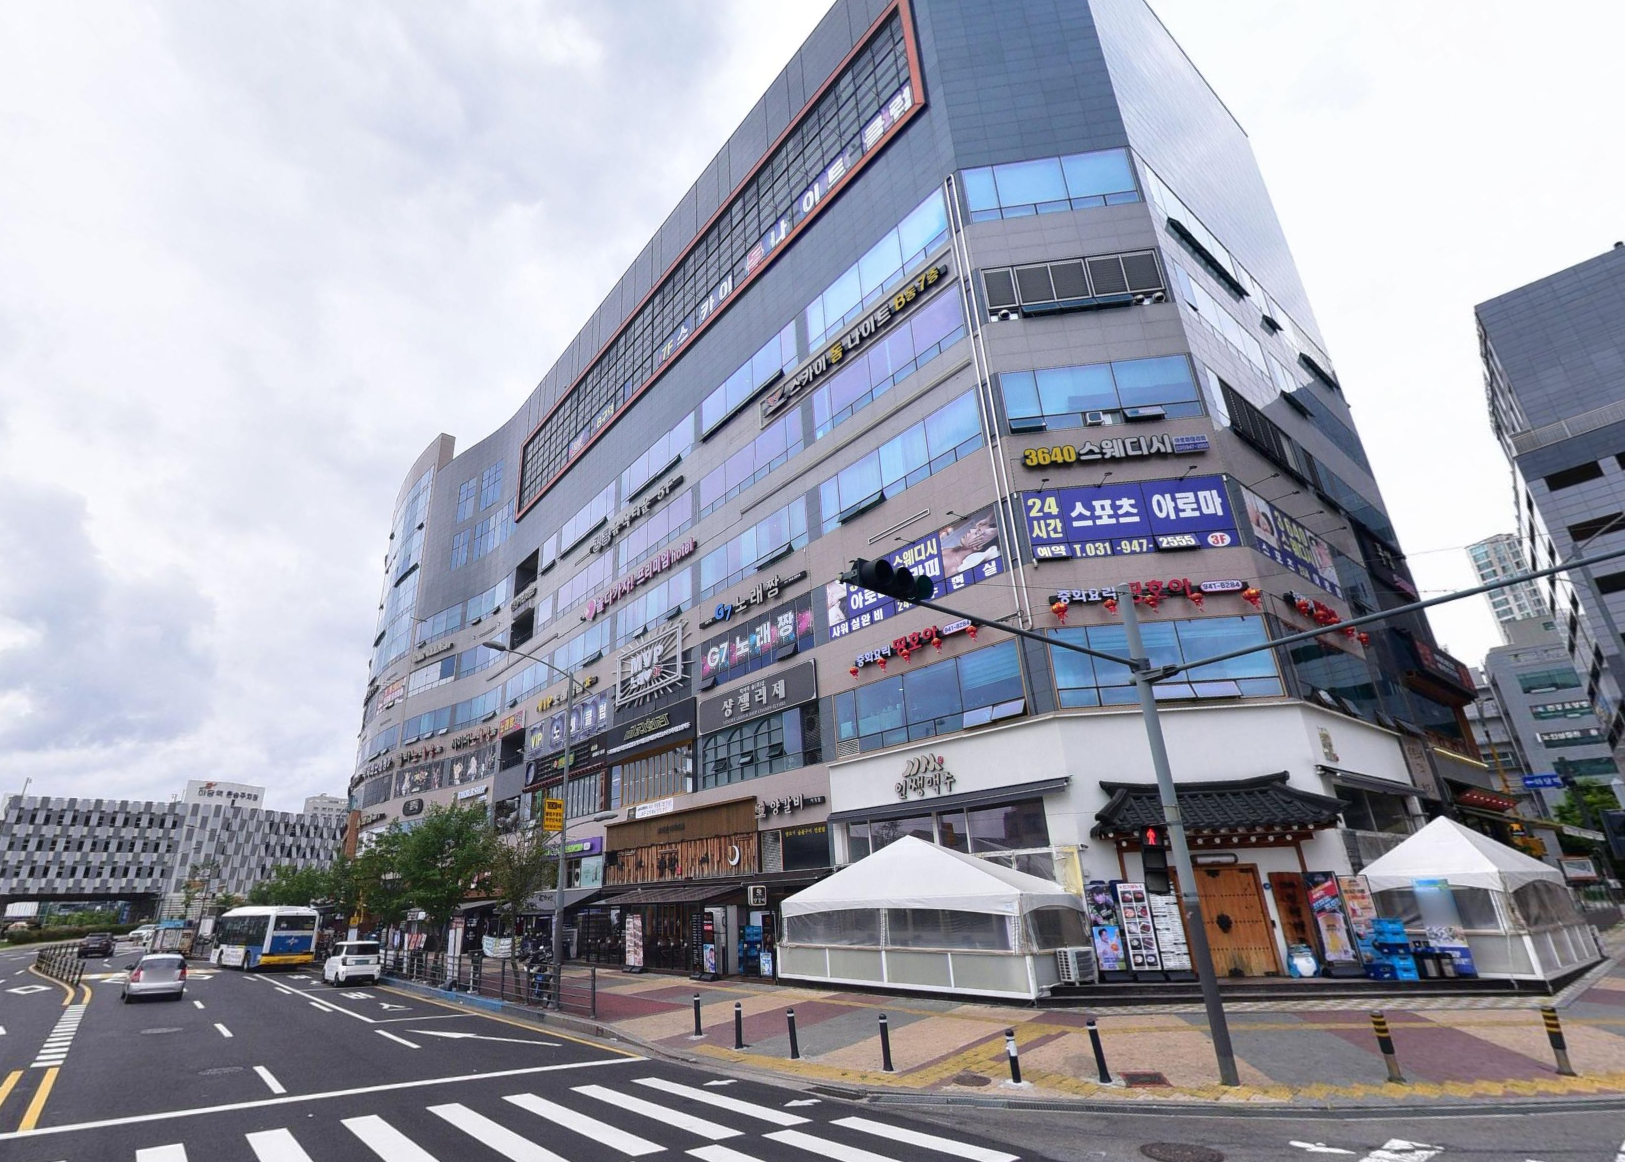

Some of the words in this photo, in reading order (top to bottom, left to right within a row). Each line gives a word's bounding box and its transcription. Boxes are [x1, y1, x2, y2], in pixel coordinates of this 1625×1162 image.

[790, 354, 826, 396] 스카이
[847, 304, 892, 348] 나이트
[1023, 446, 1076, 466] 3640
[1078, 434, 1173, 461] 스웨디시
[1027, 497, 1059, 516] 24
[1070, 497, 1140, 527] 스포츠
[1151, 490, 1223, 519] 아로마
[1031, 518, 1063, 539] 시간
[893, 538, 938, 568] 스웨디시
[1037, 545, 1066, 557] 예약
[1211, 532, 1228, 546] 3F
[636, 549, 670, 585] 프리미엄
[671, 537, 694, 563] hotel
[714, 603, 733, 621] G7
[735, 575, 780, 613] 노래짱
[1057, 587, 1117, 604] 중화요리
[1202, 582, 1241, 590] 941-8284
[707, 641, 729, 667] G7
[736, 610, 794, 656] 노래짱
[631, 645, 663, 676] MVP
[857, 645, 892, 667] 중화요리
[531, 733, 543, 749] VIP
[895, 772, 956, 799] 인쌩맥주
[770, 794, 804, 815] 양갈비
